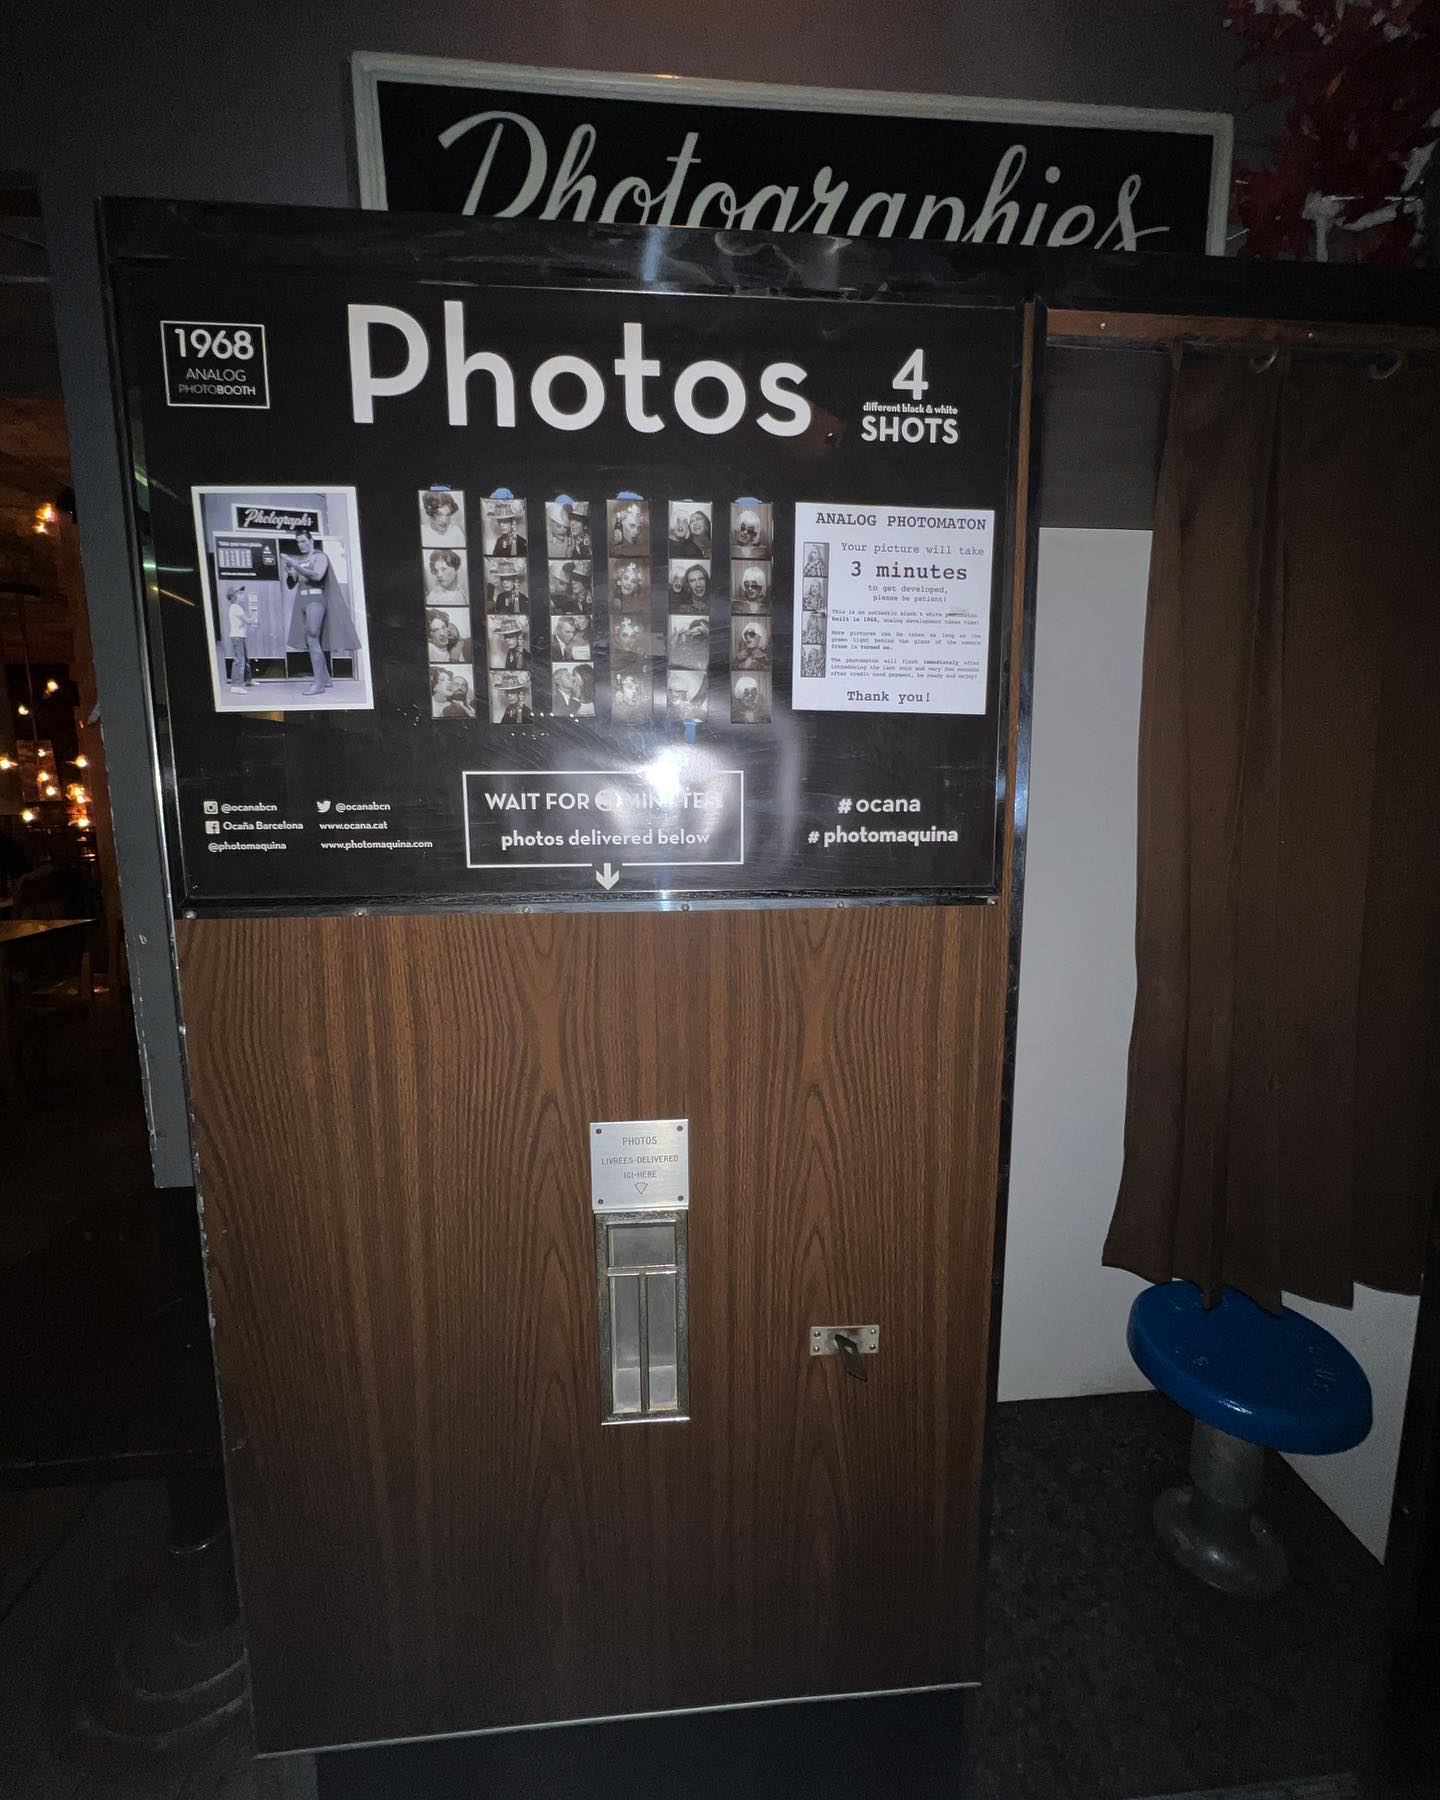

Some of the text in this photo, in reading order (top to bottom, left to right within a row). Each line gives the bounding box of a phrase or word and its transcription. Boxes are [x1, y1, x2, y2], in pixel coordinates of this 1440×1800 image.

[174, 328, 254, 360] 1968
[186, 368, 247, 382] ANALOG
[347, 300, 812, 437] Photos
[892, 348, 929, 400] 4
[179, 384, 256, 396] PHOTOBOOTH
[863, 402, 958, 415] different black & white
[861, 415, 959, 444] SHOTS
[244, 508, 314, 530] Photographs
[816, 512, 987, 531] ANALOG PHOTOMATON
[841, 542, 984, 556] Your picture will take
[850, 560, 967, 580] 3 minutes
[901, 585, 948, 594] developed,
[873, 594, 898, 602] please
[847, 690, 930, 705] Thank you!
[221, 801, 277, 814] @ocanabcn
[335, 801, 391, 813] @ocanabcn
[484, 792, 540, 811] WAIT
[546, 792, 590, 810] FOR
[222, 820, 304, 831] Ocaña Barcelona
[319, 820, 388, 831] www.ocana.cat
[208, 840, 287, 853] @photomaquina
[321, 839, 433, 851] www.photomaquina.com
[501, 828, 710, 851] photos delivered below
[622, 1136, 658, 1146] PHOTOS
